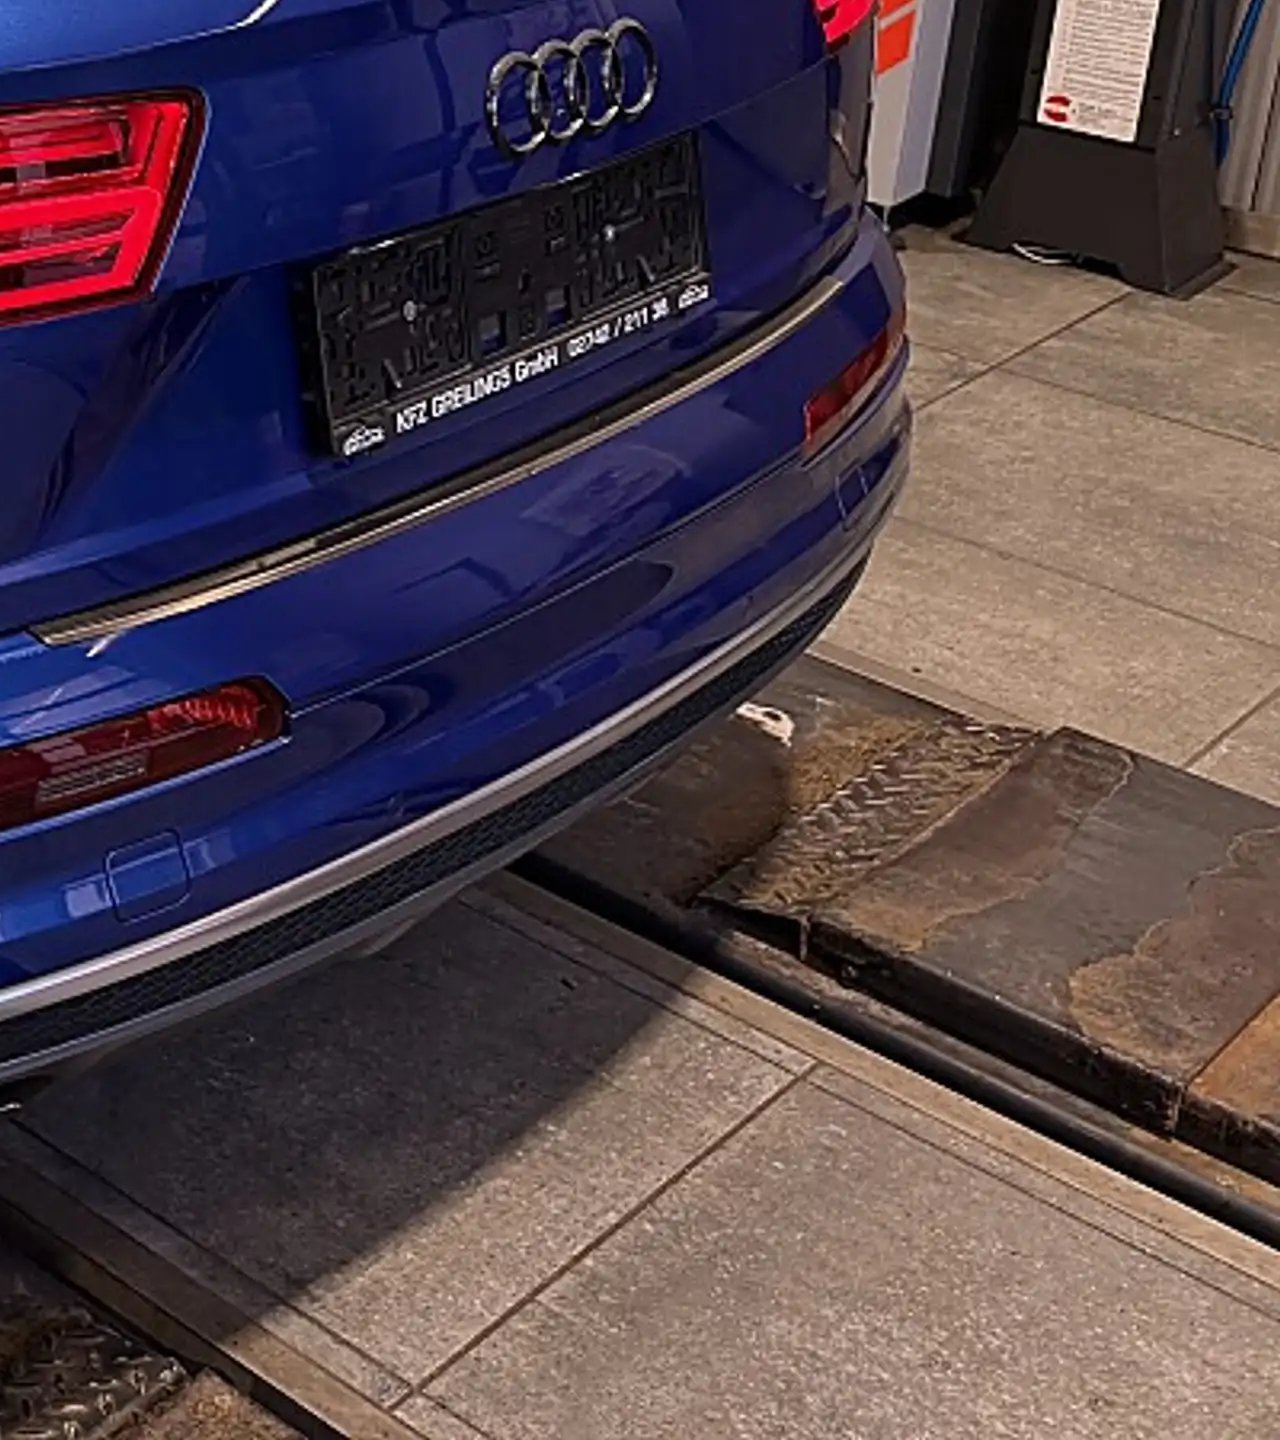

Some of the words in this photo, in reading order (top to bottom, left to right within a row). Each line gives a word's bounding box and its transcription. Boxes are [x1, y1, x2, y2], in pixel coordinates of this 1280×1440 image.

[396, 400, 430, 434] KFZ
[432, 365, 513, 418] GREILINGS
[514, 346, 559, 382] GmbH
